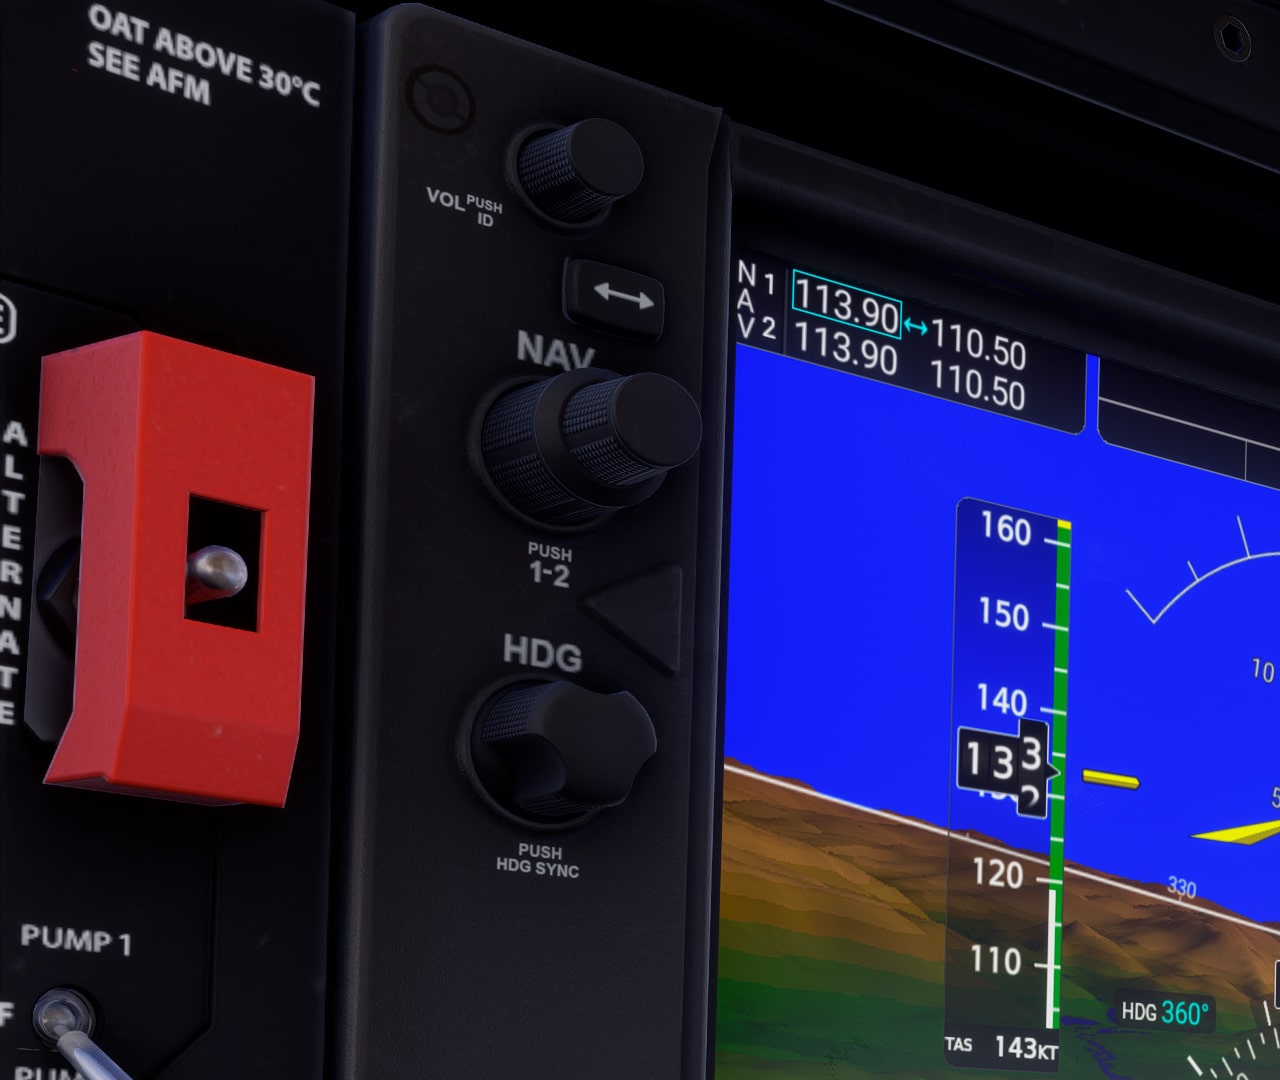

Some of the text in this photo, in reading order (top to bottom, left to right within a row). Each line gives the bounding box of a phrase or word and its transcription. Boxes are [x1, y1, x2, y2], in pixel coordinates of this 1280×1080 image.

[89, 3, 149, 47] OAT
[155, 26, 253, 85] ABOVE
[88, 43, 211, 106] SEE AFM
[795, 278, 899, 336] 113.90
[932, 318, 1027, 371] 110.50
[516, 329, 595, 372] NAV
[795, 320, 898, 377] 113.90
[930, 359, 1025, 412] 110.50
[982, 510, 1031, 546] 160
[528, 542, 572, 563] PUSH
[529, 561, 570, 588] 1-2
[979, 596, 1029, 632] 150
[503, 634, 583, 672] HDG
[977, 683, 1028, 718] 140
[973, 856, 1024, 890] 120
[971, 943, 1022, 976] 110
[1121, 1000, 1209, 1027] HDG 360°
